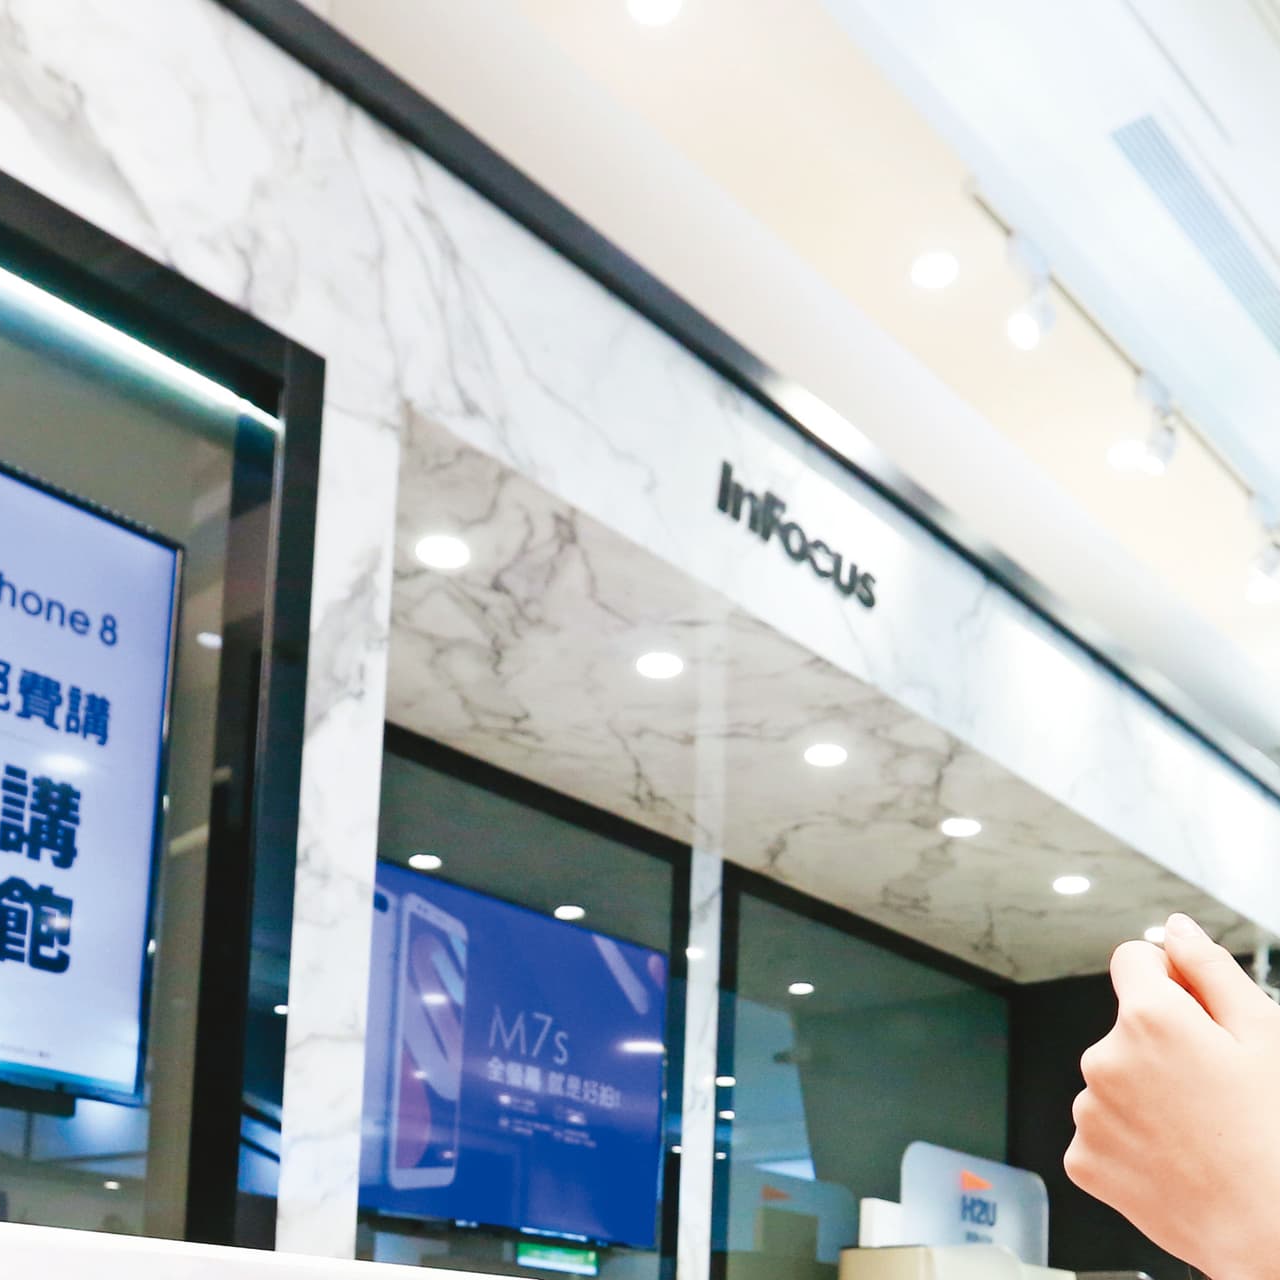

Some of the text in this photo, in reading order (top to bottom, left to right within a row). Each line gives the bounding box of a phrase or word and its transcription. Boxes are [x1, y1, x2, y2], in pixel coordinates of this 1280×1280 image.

[718, 459, 876, 609] InFocus
[99, 614, 118, 647] 8
[489, 1004, 569, 1066] M7s
